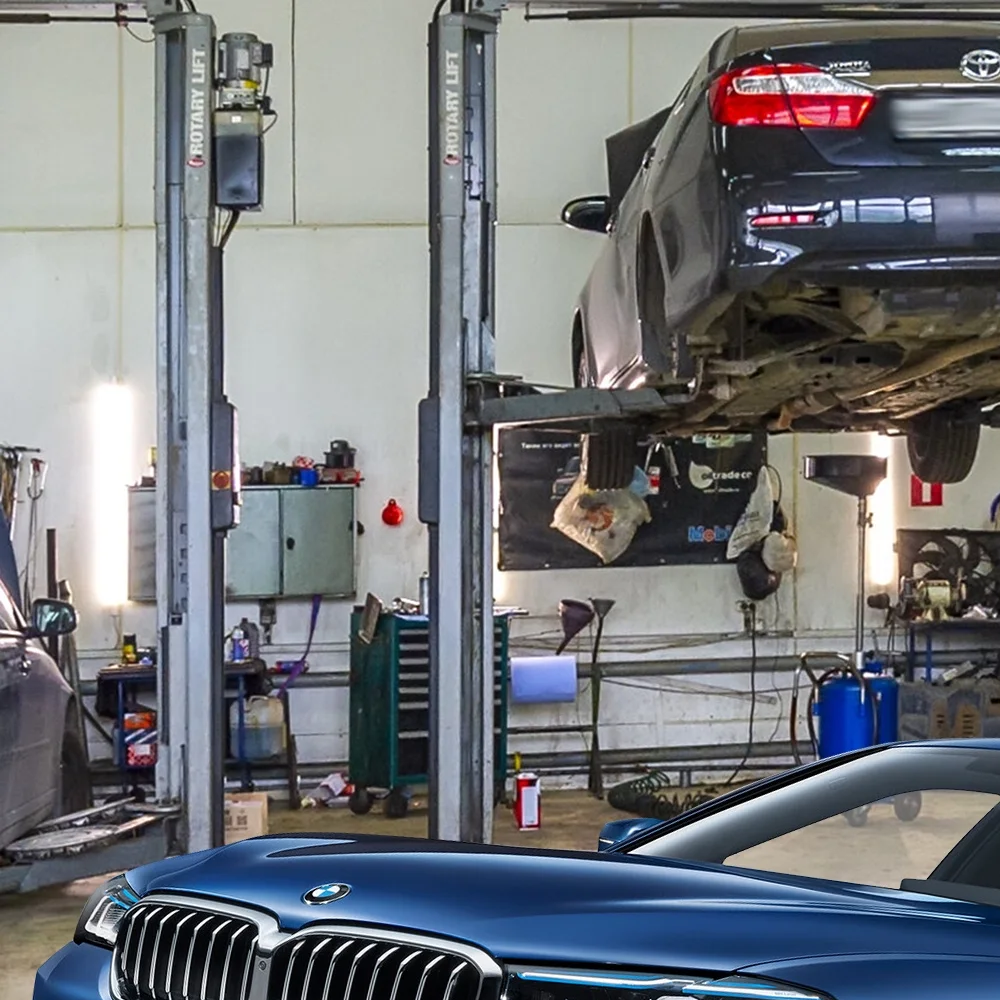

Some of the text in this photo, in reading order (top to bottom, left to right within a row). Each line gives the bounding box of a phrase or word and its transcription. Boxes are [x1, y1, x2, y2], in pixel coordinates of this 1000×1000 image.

[191, 48, 206, 84] LIFT
[445, 49, 459, 85] LIFT
[189, 88, 205, 156] ROTARY
[445, 89, 459, 155] ROTARY
